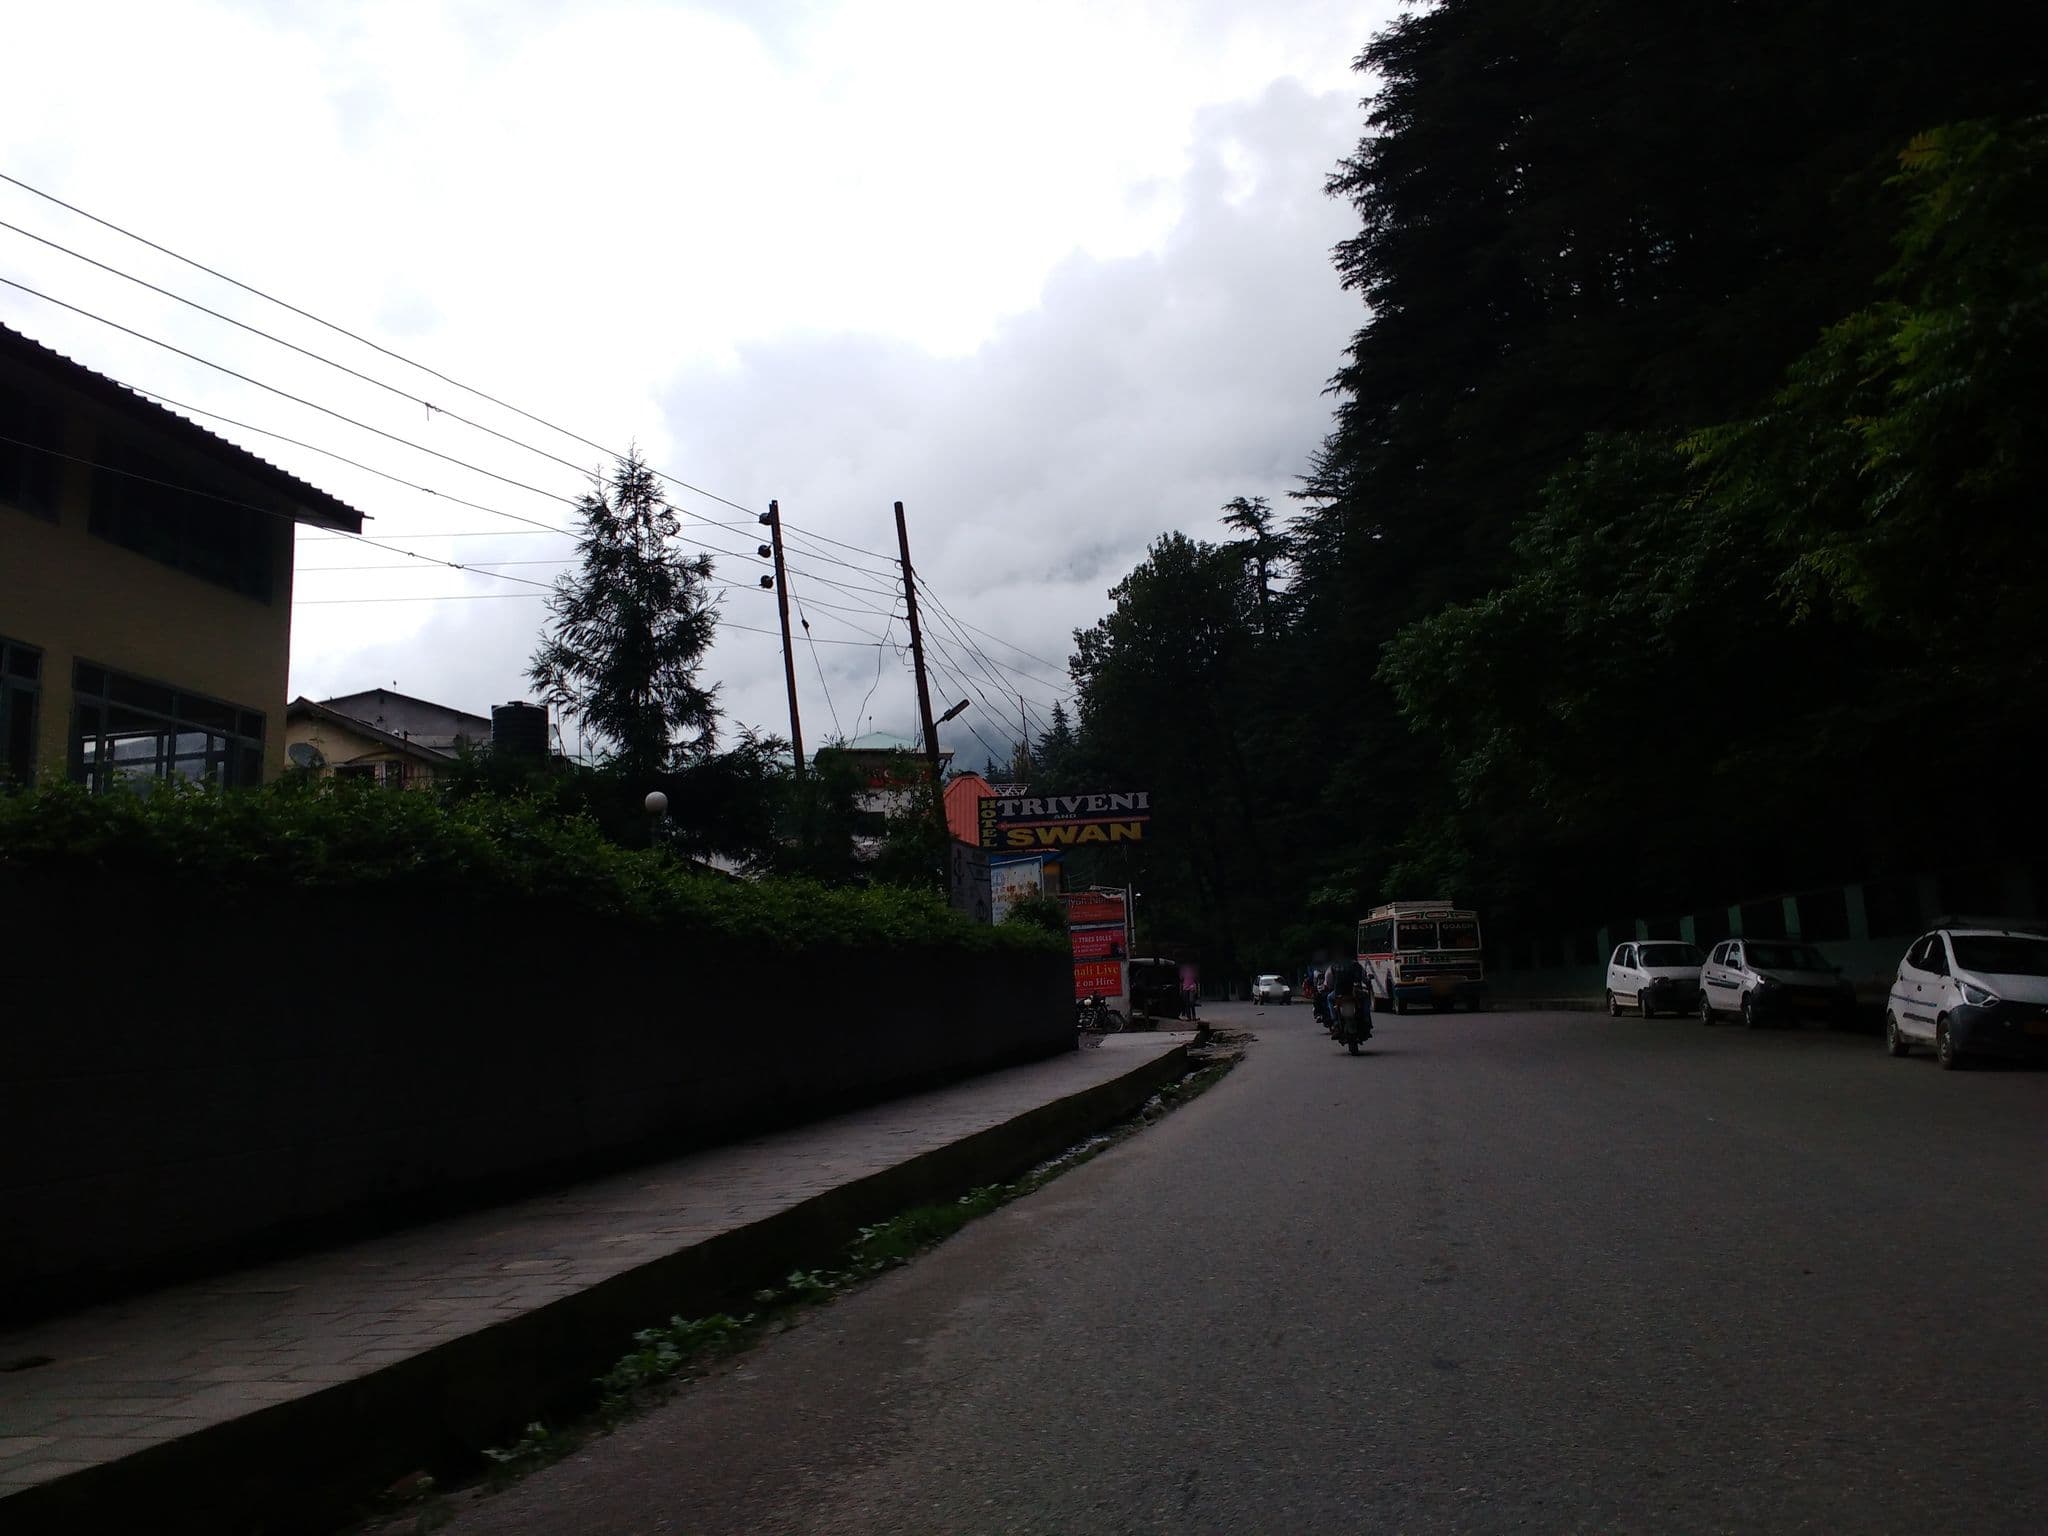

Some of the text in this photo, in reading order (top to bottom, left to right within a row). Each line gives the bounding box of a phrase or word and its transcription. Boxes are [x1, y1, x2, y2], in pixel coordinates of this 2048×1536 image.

[997, 791, 1150, 817] TRIVENI
[980, 798, 997, 848] HOTEL
[1007, 822, 1143, 847] SWAN
[1096, 964, 1120, 976] Live
